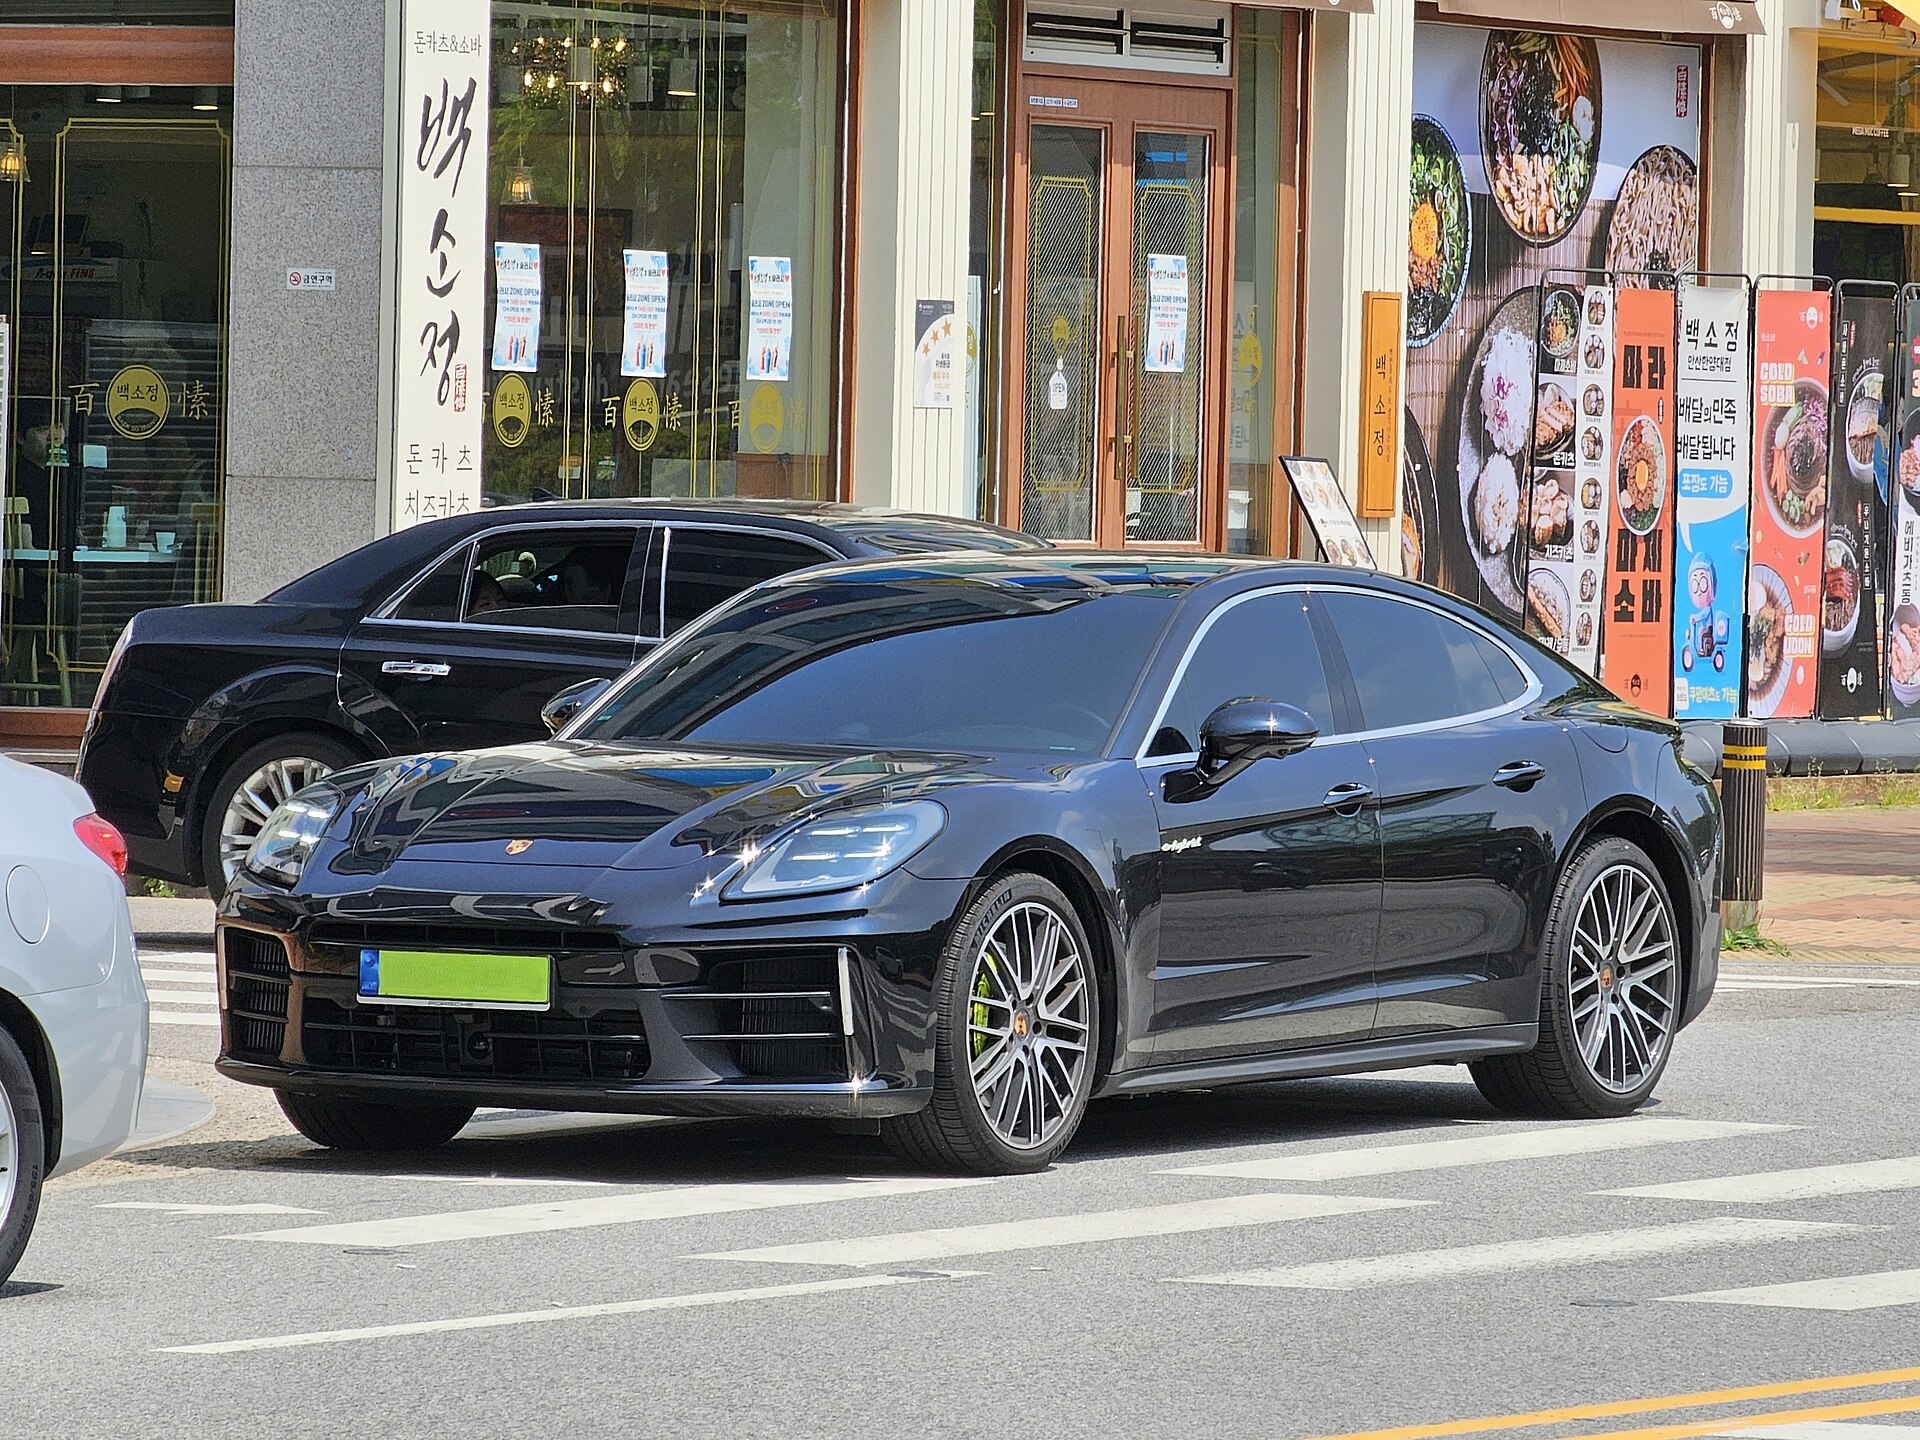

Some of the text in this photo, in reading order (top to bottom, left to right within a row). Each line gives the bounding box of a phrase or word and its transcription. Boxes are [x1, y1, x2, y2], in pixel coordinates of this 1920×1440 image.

[414, 31, 482, 57] 돈카츠&소바
[417, 77, 477, 406] 백소정
[304, 275, 332, 284] 금연구역
[510, 288, 523, 296] ZONE
[524, 288, 539, 297] OPEN
[638, 294, 651, 302] ZONE
[651, 295, 666, 303] OPEN
[763, 300, 775, 308] ZONE
[776, 300, 790, 309] OPEN
[1161, 295, 1172, 303] ZONE
[1173, 295, 1186, 304] OPEN
[1686, 318, 1739, 353] 백소정
[1622, 345, 1666, 390] 마라
[1687, 355, 1732, 373] 안산한양대점
[1760, 362, 1793, 383] COLD
[68, 382, 100, 416] 百
[116, 383, 159, 402] 백소정
[499, 392, 524, 411] 백소정
[1373, 353, 1386, 457] 백소정
[1760, 385, 1794, 405] SOBA
[602, 396, 620, 429] 百
[630, 396, 653, 414] 백소정
[1678, 397, 1737, 425] 배달의민족
[406, 442, 473, 475] 돈카츠
[1677, 435, 1737, 462] 배달됩니다
[1681, 473, 1729, 494] 포장도 가능
[404, 489, 470, 522] 치즈카츠
[1901, 520, 1915, 604] 에비가츠동
[1614, 579, 1663, 623] 소바
[1785, 614, 1815, 634] COLD
[1784, 636, 1814, 656] UDON
